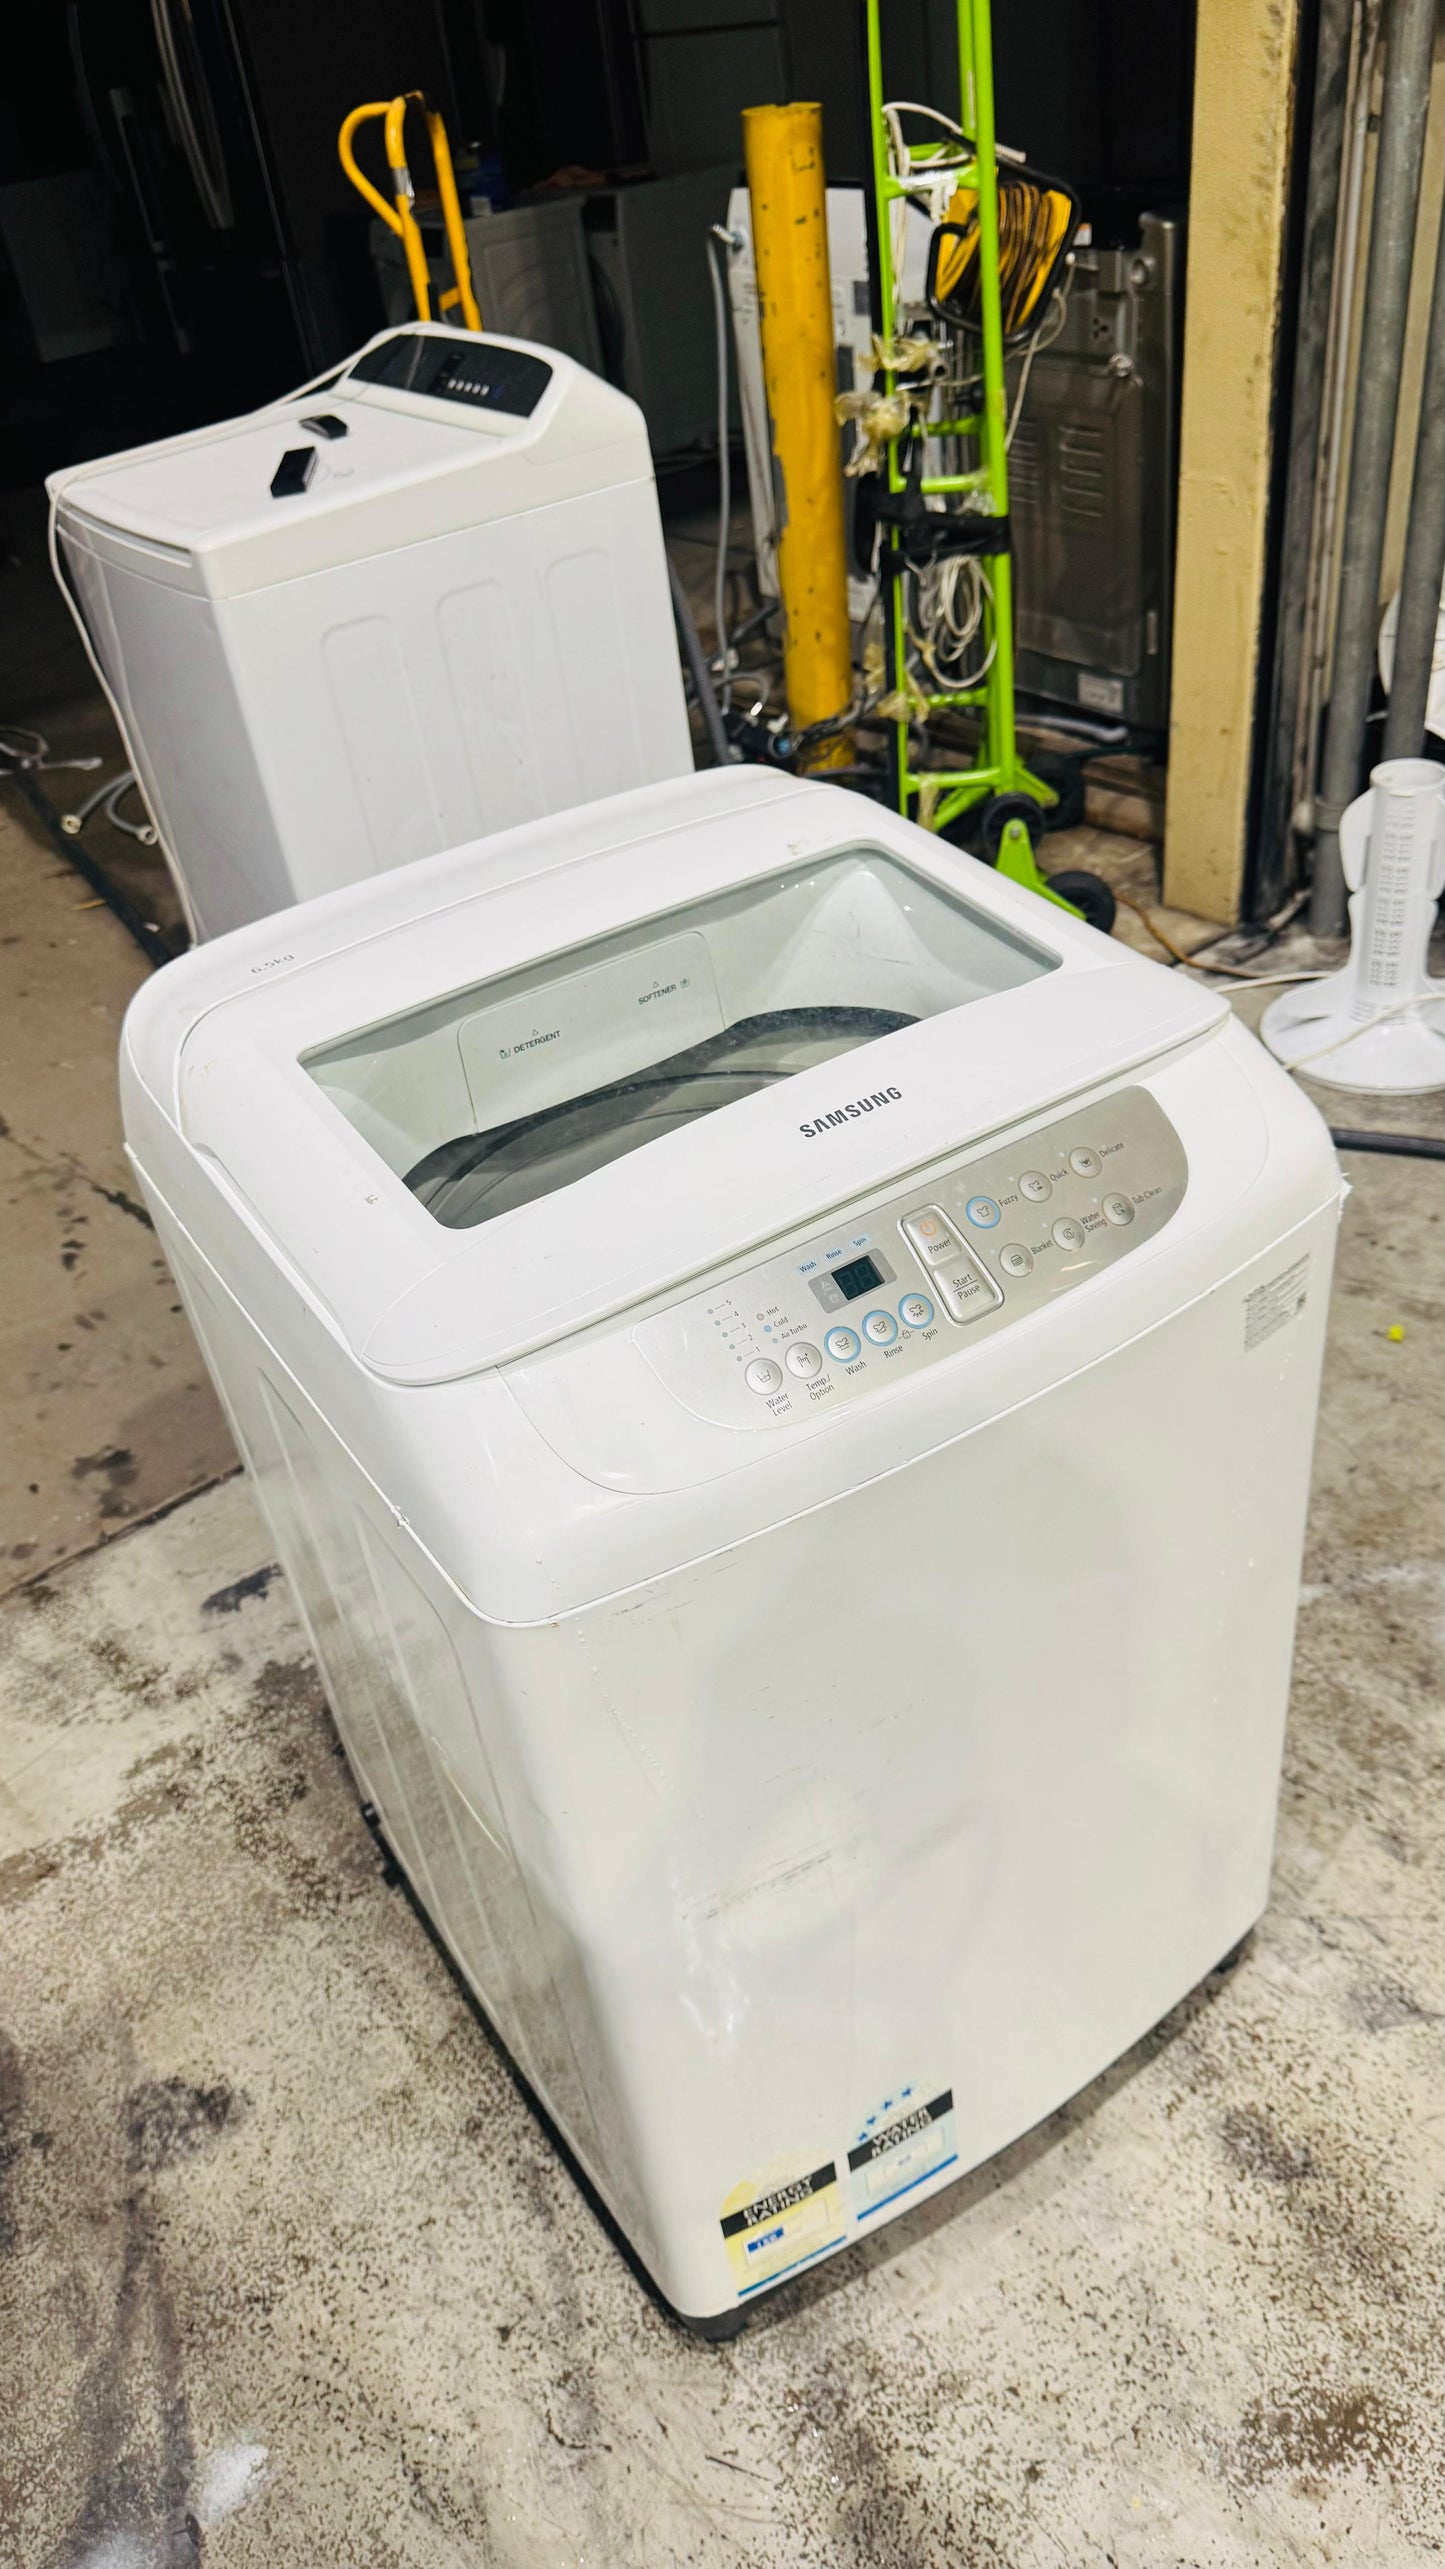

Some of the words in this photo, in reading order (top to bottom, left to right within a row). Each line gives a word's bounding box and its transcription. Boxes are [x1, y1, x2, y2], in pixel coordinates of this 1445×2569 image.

[638, 984, 677, 1005] SOFTENER
[513, 1030, 561, 1054] DETERGENT
[799, 1087, 902, 1138] SAMSUNG
[1099, 1142, 1125, 1158] Delicate
[1049, 1168, 1069, 1182] Quick
[998, 1194, 1019, 1207] Fuzzy
[1080, 1212, 1101, 1225] Water
[1085, 1218, 1108, 1233] Saving
[928, 1239, 951, 1254] Power
[1031, 1240, 1053, 1255] Blanket
[800, 1261, 817, 1273] Wash
[826, 1249, 842, 1260] Rinse
[853, 1237, 867, 1247] Spin
[952, 1274, 973, 1287] Start
[957, 1285, 980, 1300] Pause
[766, 1306, 779, 1316] Hot
[773, 1316, 789, 1328] Cold
[922, 1327, 938, 1341] Spin
[883, 1345, 904, 1359] Rinse
[845, 1360, 867, 1376] Wash
[765, 1392, 789, 1409] Water
[809, 1384, 835, 1402] Option
[772, 1402, 793, 1417] Level
[871, 2116, 933, 2159] RATING
[743, 2175, 813, 2219] ENERGY
[747, 2187, 814, 2228] RATING
